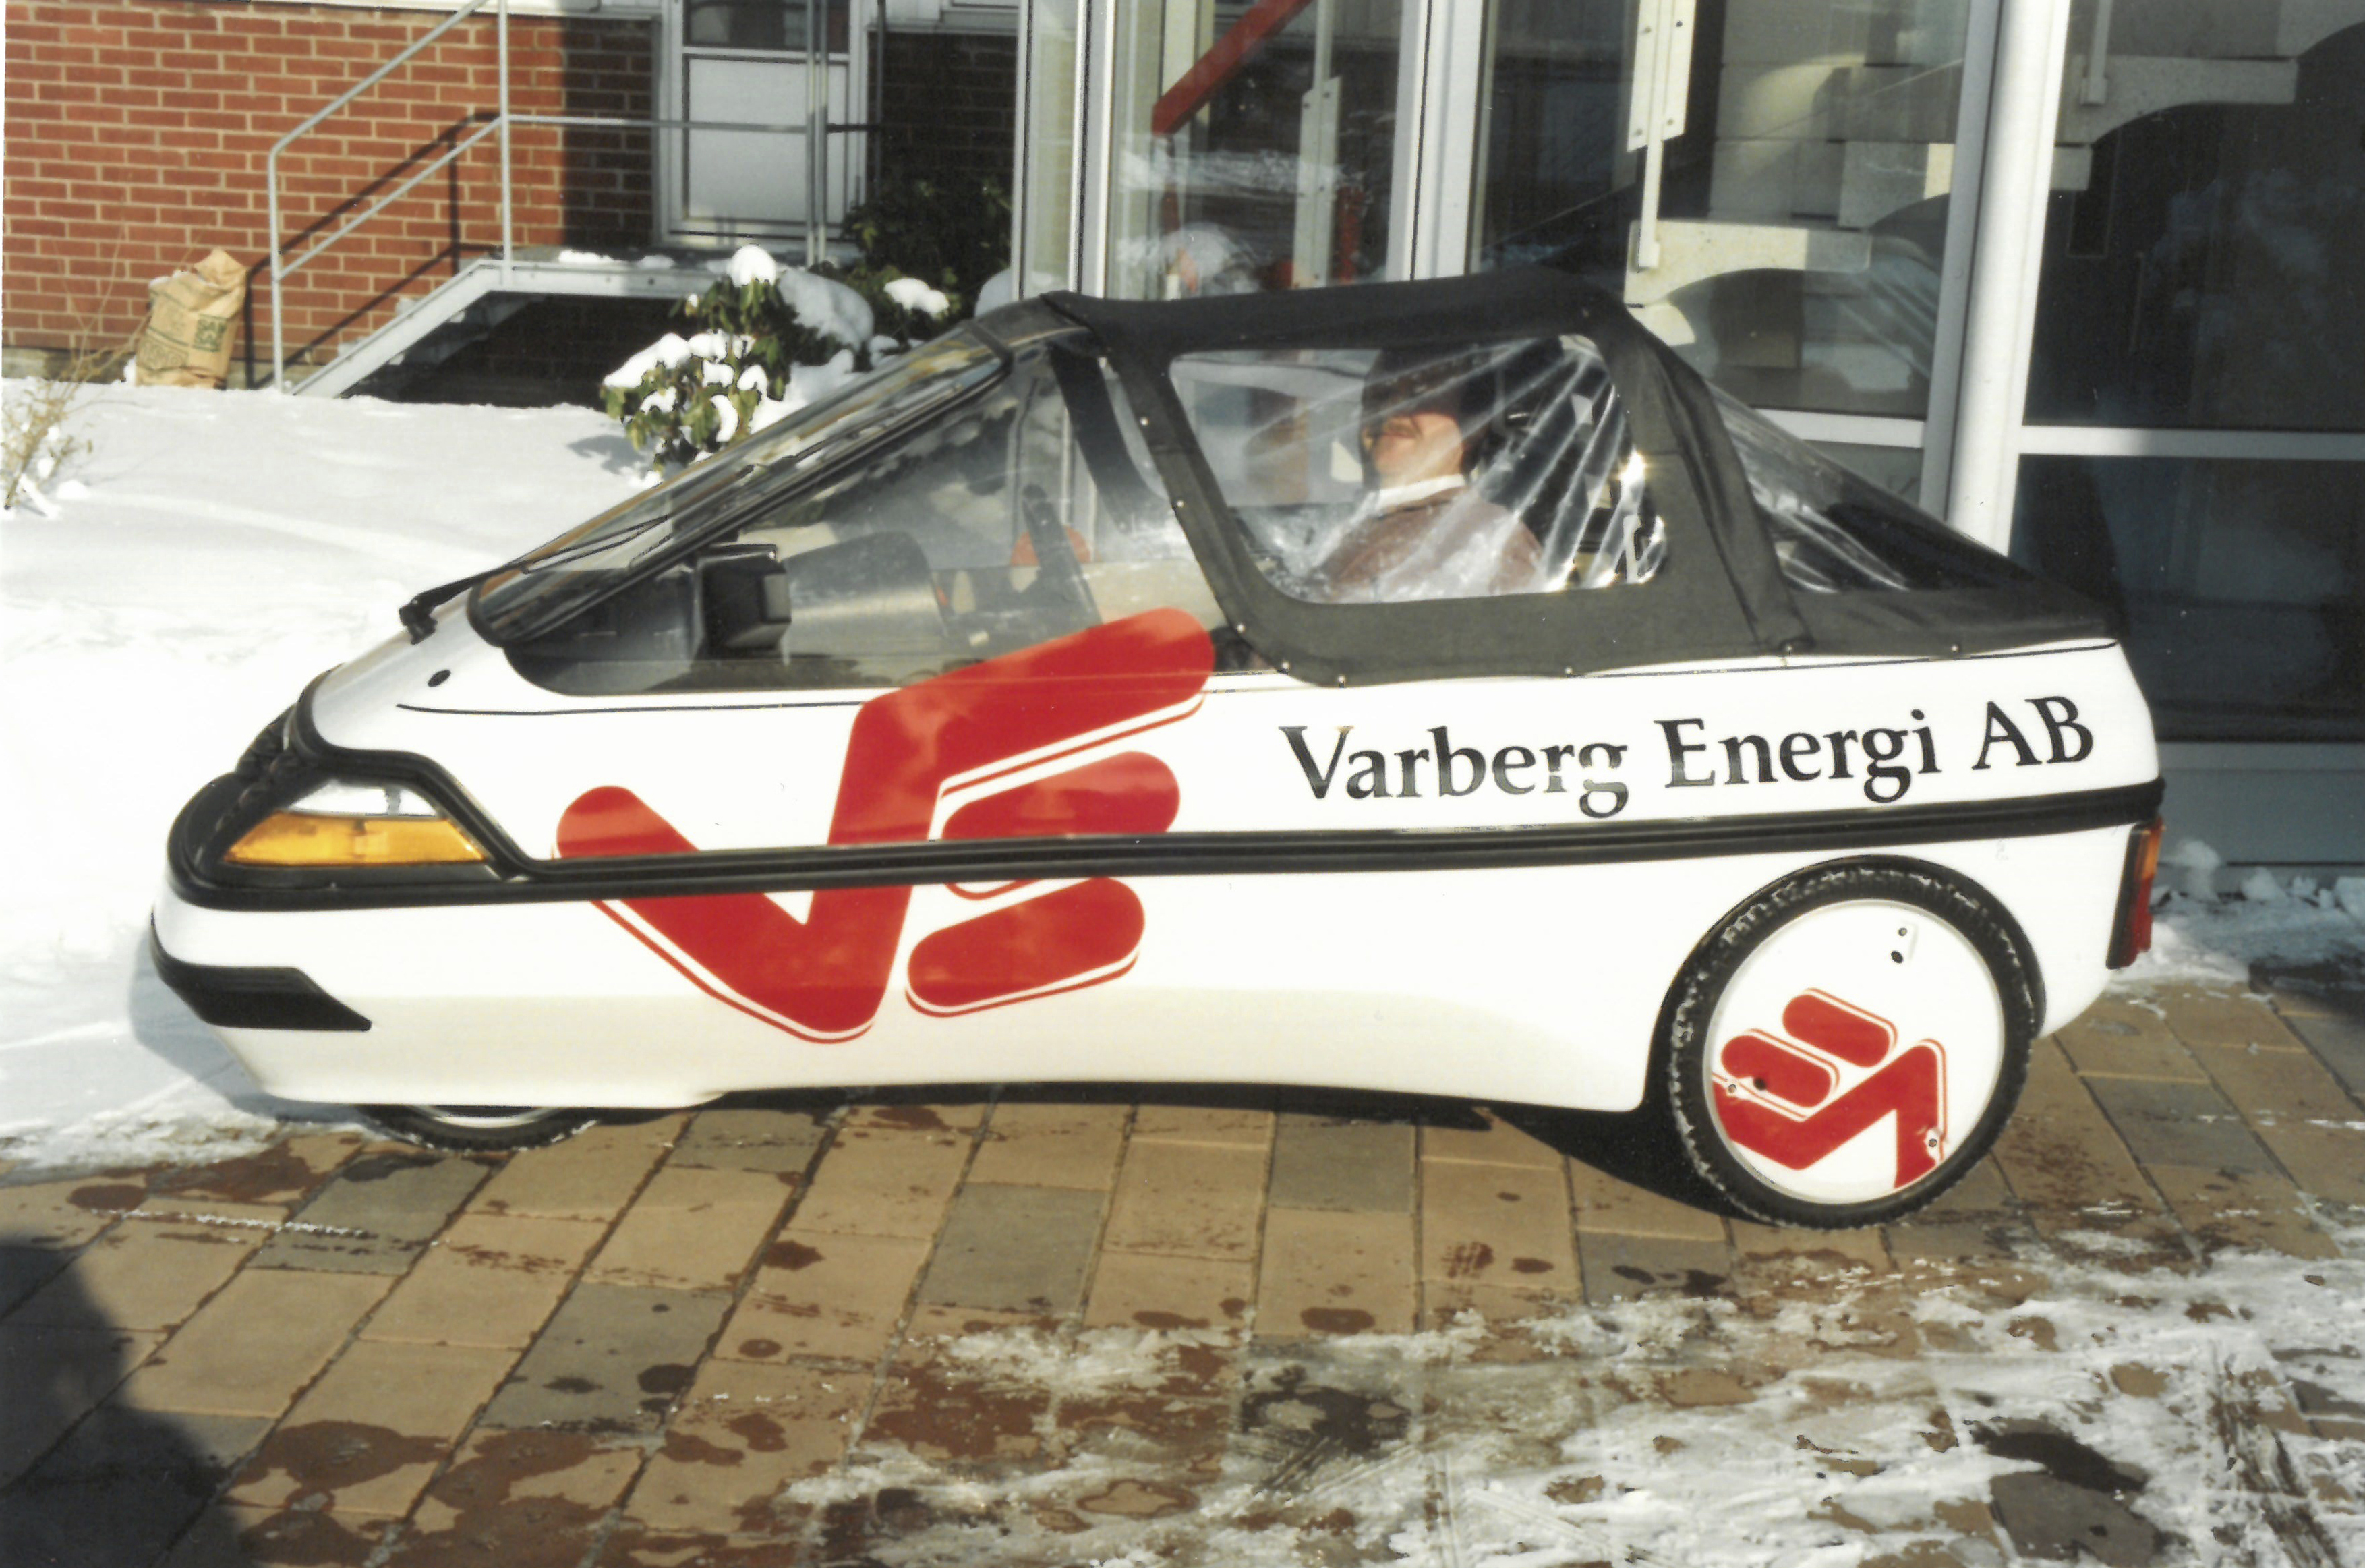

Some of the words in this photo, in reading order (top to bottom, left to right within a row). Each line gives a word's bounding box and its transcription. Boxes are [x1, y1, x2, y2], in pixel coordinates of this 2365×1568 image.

[1279, 726, 1629, 819] Varberg
[1653, 709, 1942, 804] Energi
[1971, 695, 2094, 770] AB
